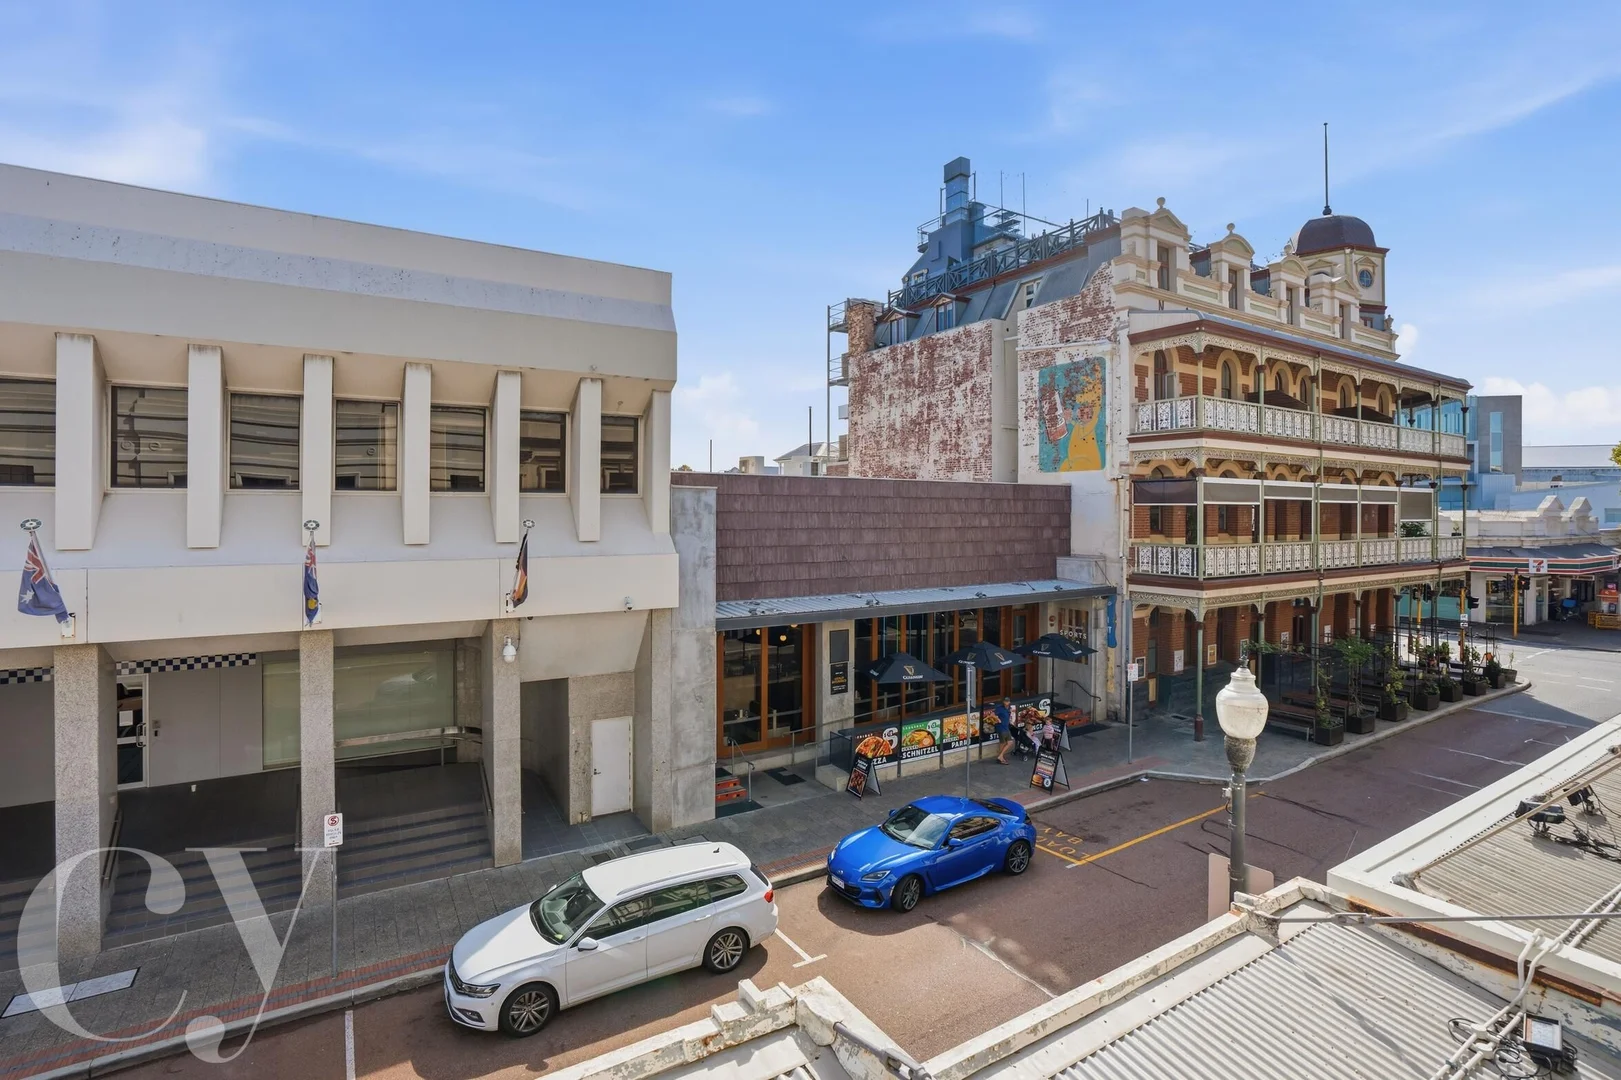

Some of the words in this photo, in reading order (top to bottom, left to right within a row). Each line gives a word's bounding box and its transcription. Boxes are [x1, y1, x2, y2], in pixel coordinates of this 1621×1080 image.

[1059, 629, 1087, 640] SPORTS
[902, 746, 939, 759] SCHNITZEL
[872, 756, 887, 765] ZZA
